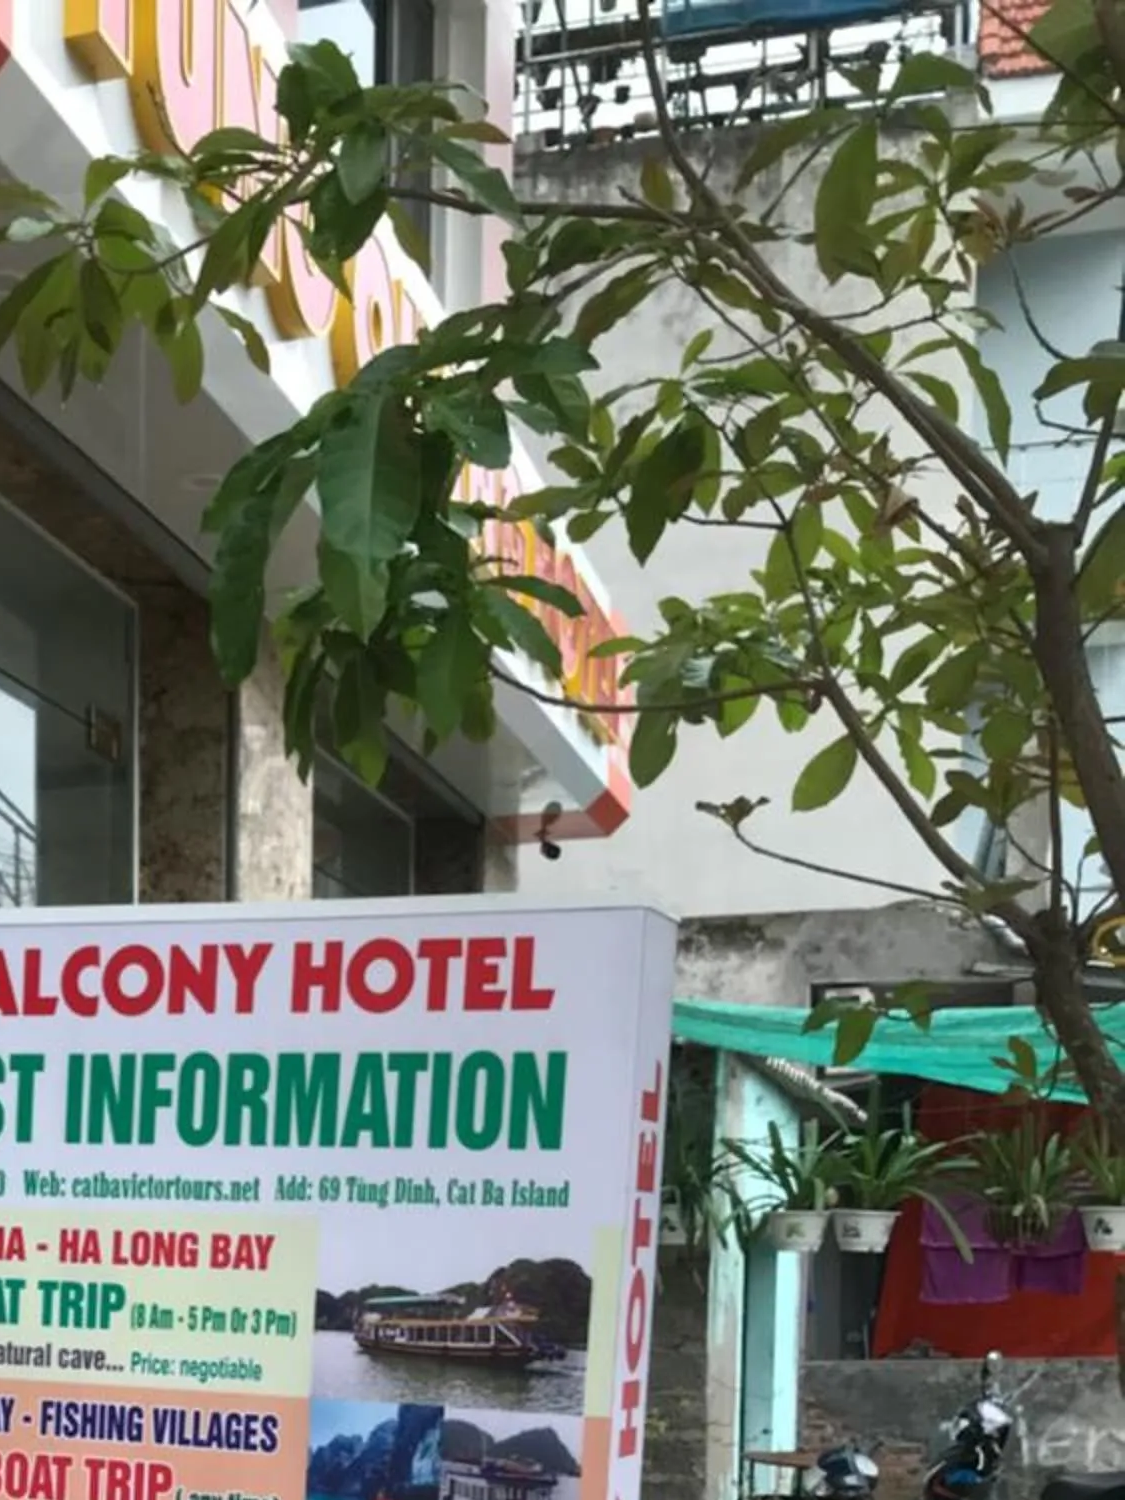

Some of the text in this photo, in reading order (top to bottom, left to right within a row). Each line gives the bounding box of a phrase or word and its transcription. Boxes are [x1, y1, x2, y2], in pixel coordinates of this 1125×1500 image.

[291, 937, 555, 1014] HOTEL
[64, 1050, 569, 1151] INFORMATION
[23, 1170, 66, 1197] Web:
[71, 1170, 260, 1202] catbavictortours.net
[275, 1175, 312, 1201] Add:
[447, 1178, 476, 1205] Cat
[481, 1179, 504, 1206] Ba
[511, 1180, 570, 1207] Island
[59, 1229, 101, 1264] HA
[112, 1231, 198, 1267] LONG
[210, 1234, 274, 1271] BAY
[618, 1059, 663, 1457] HOTEL
[38, 1281, 126, 1330] TRIP
[59, 1349, 124, 1374] cave...
[130, 1352, 175, 1375] Price:
[180, 1357, 262, 1383] negotiable
[40, 1400, 142, 1442] FISHING
[153, 1409, 278, 1453] VILLAGES
